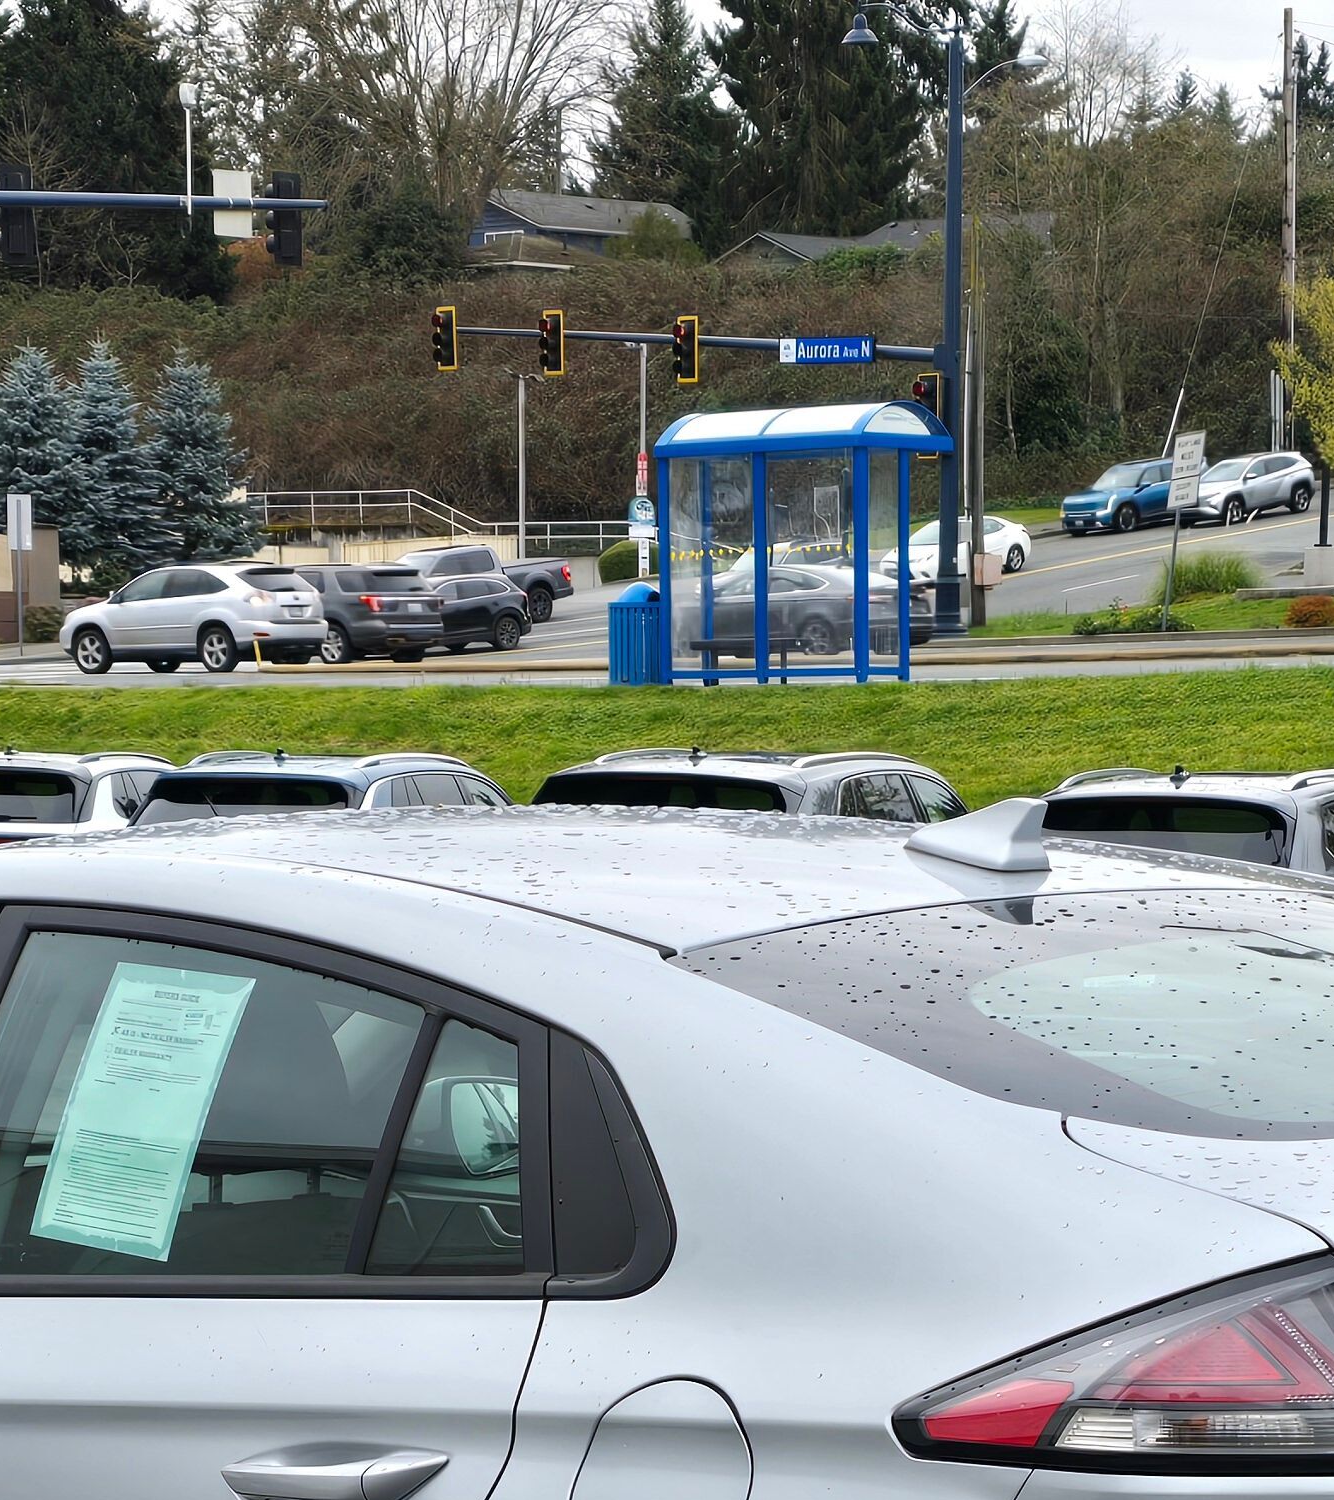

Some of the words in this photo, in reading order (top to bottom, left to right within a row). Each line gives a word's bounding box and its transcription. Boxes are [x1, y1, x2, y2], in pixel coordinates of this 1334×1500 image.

[797, 341, 840, 359] Aurora
[842, 346, 859, 358] Ave
[861, 339, 870, 358] N
